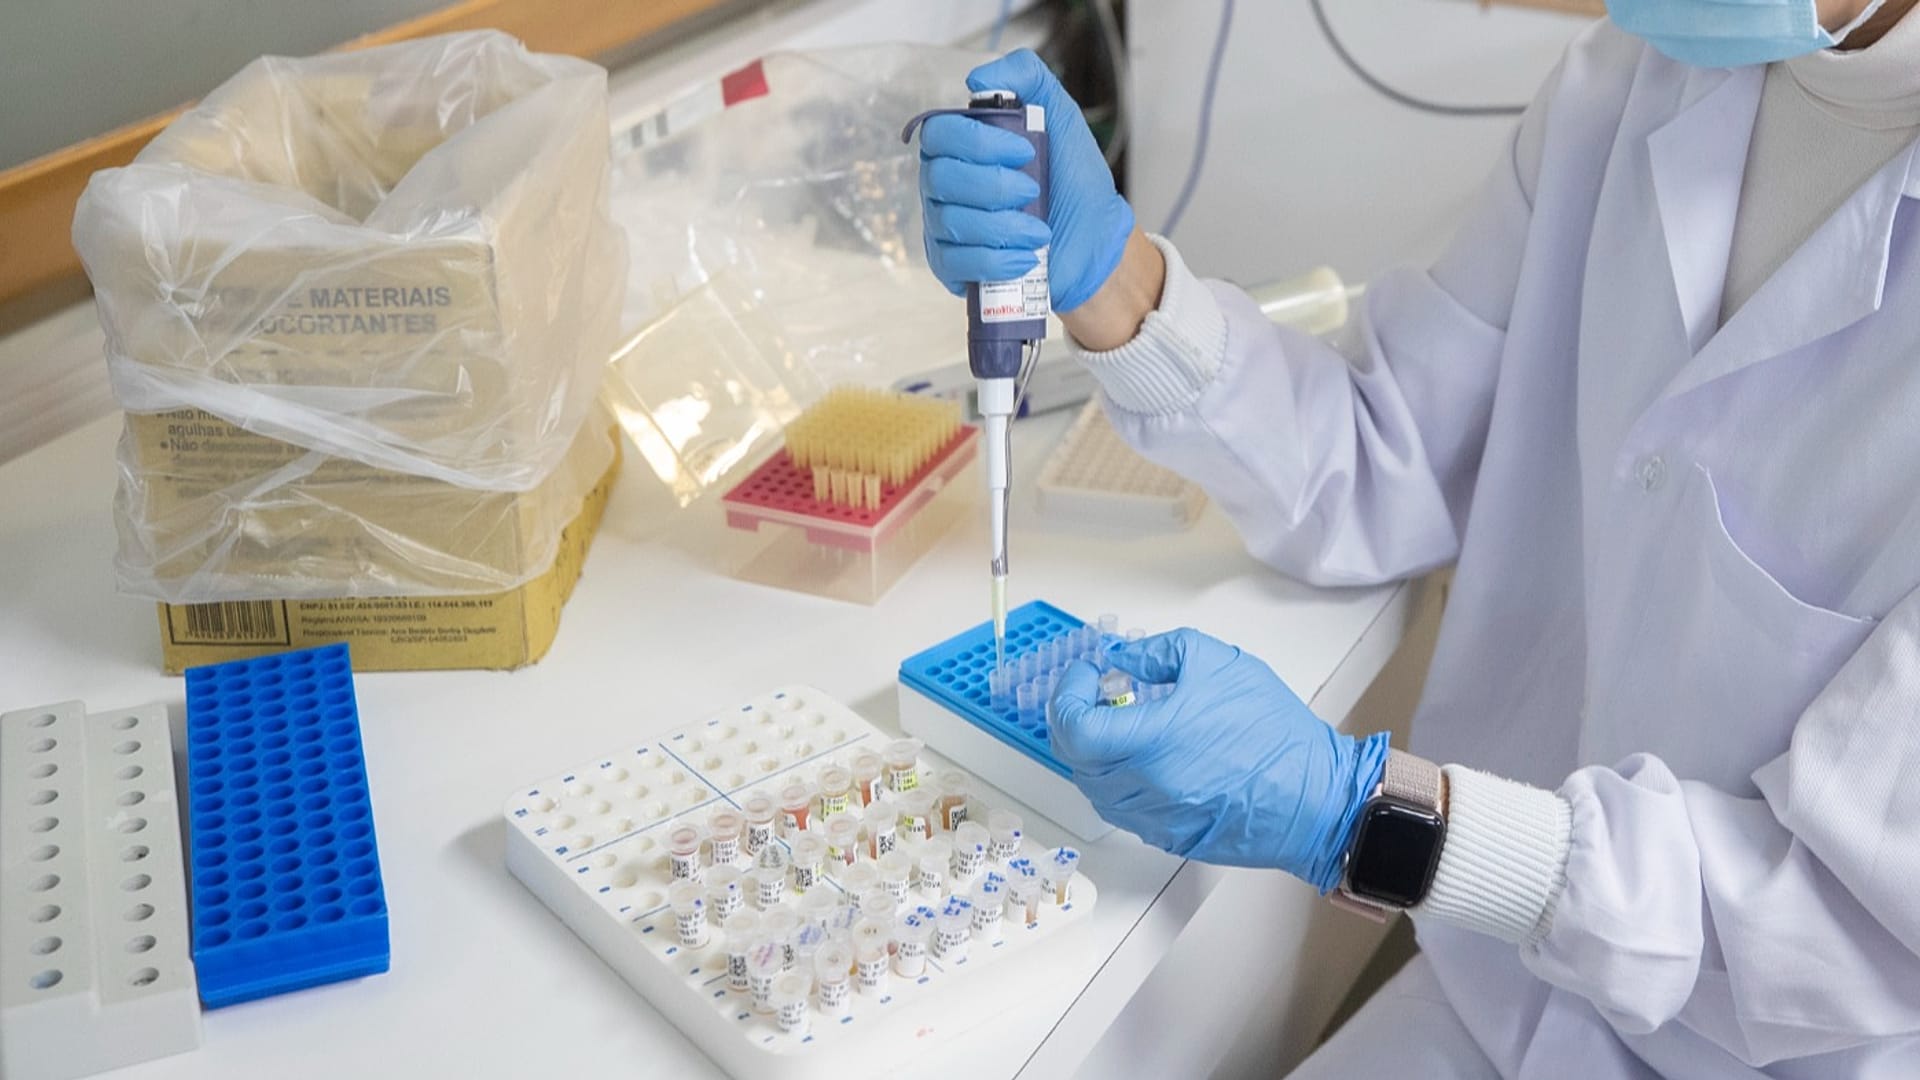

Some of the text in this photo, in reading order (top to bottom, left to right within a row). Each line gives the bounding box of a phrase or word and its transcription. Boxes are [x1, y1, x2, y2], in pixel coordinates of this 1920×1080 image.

[309, 286, 450, 308] MATERIAIS
[168, 424, 223, 438] agulhas
[170, 438, 199, 452] Não
